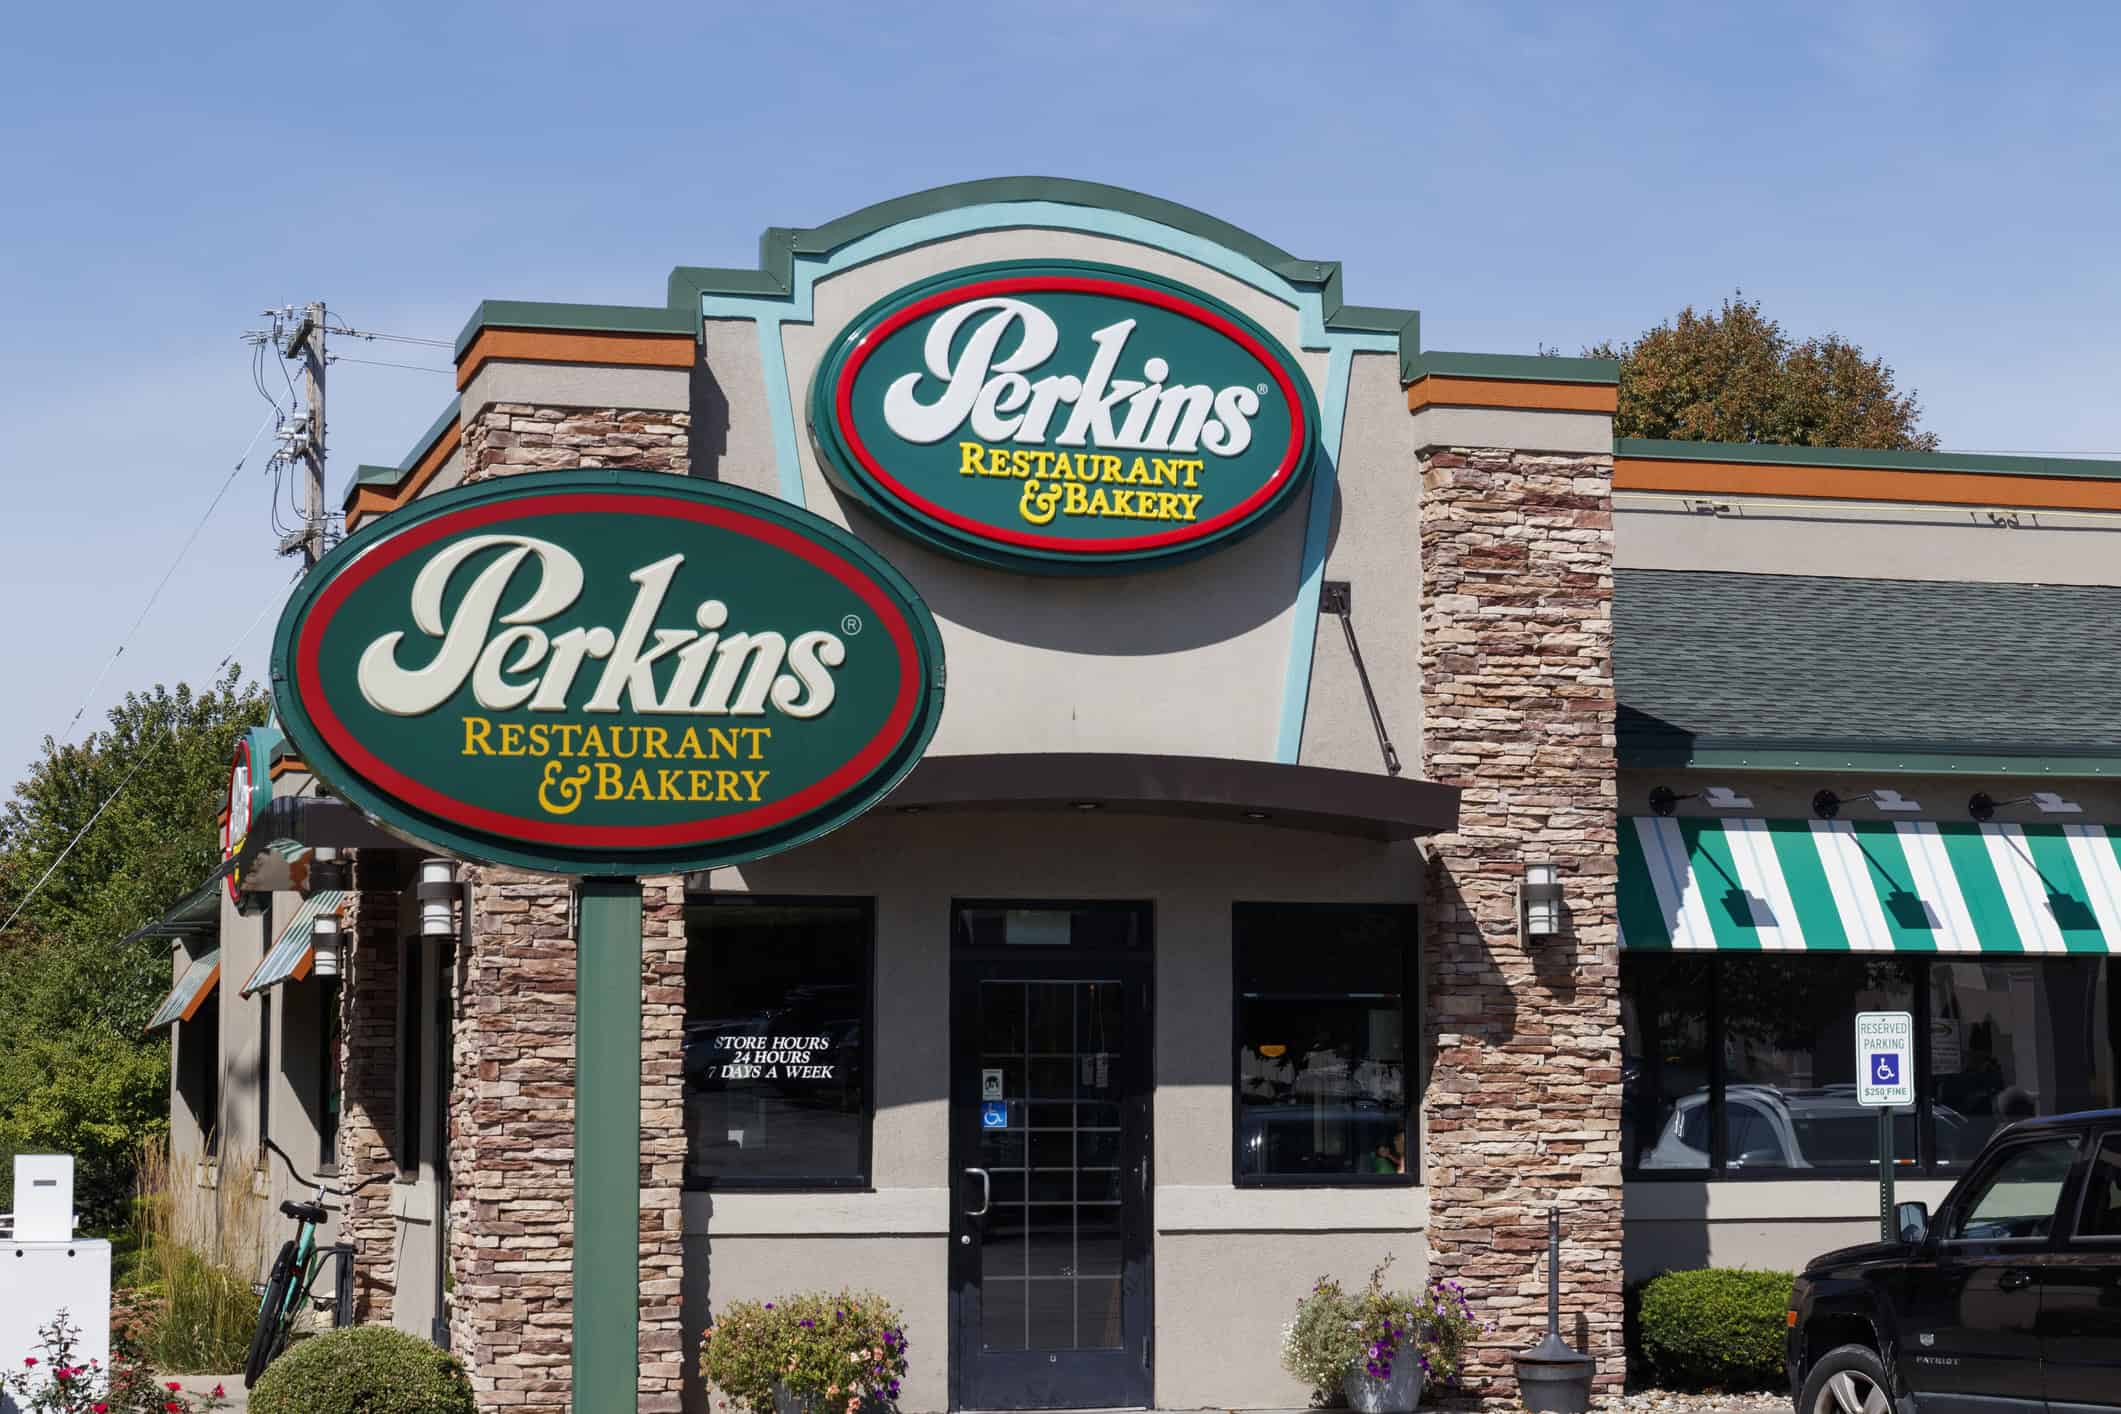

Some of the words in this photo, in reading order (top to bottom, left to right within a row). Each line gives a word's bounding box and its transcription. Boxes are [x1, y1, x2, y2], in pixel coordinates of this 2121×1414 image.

[883, 297, 1260, 456] Perkins
[959, 443, 1204, 487] RESTAURANT
[357, 534, 846, 717] Perkins
[461, 717, 771, 759] RESTAURANT
[1860, 1023, 1907, 1034] RESERVED
[713, 1036, 767, 1050] STORE
[771, 1036, 830, 1050] HOURS
[1863, 1038, 1905, 1049] PARKING
[733, 1050, 750, 1064] 24
[752, 1050, 811, 1064] HOURS
[708, 1065, 717, 1079] 7
[720, 1065, 762, 1079] DAYS
[764, 1065, 778, 1079] A
[785, 1065, 834, 1079] WEEK
[1864, 1087, 1885, 1096] $250
[1887, 1087, 1907, 1096] FINE
[1915, 1355, 1960, 1366] PATRIOT
